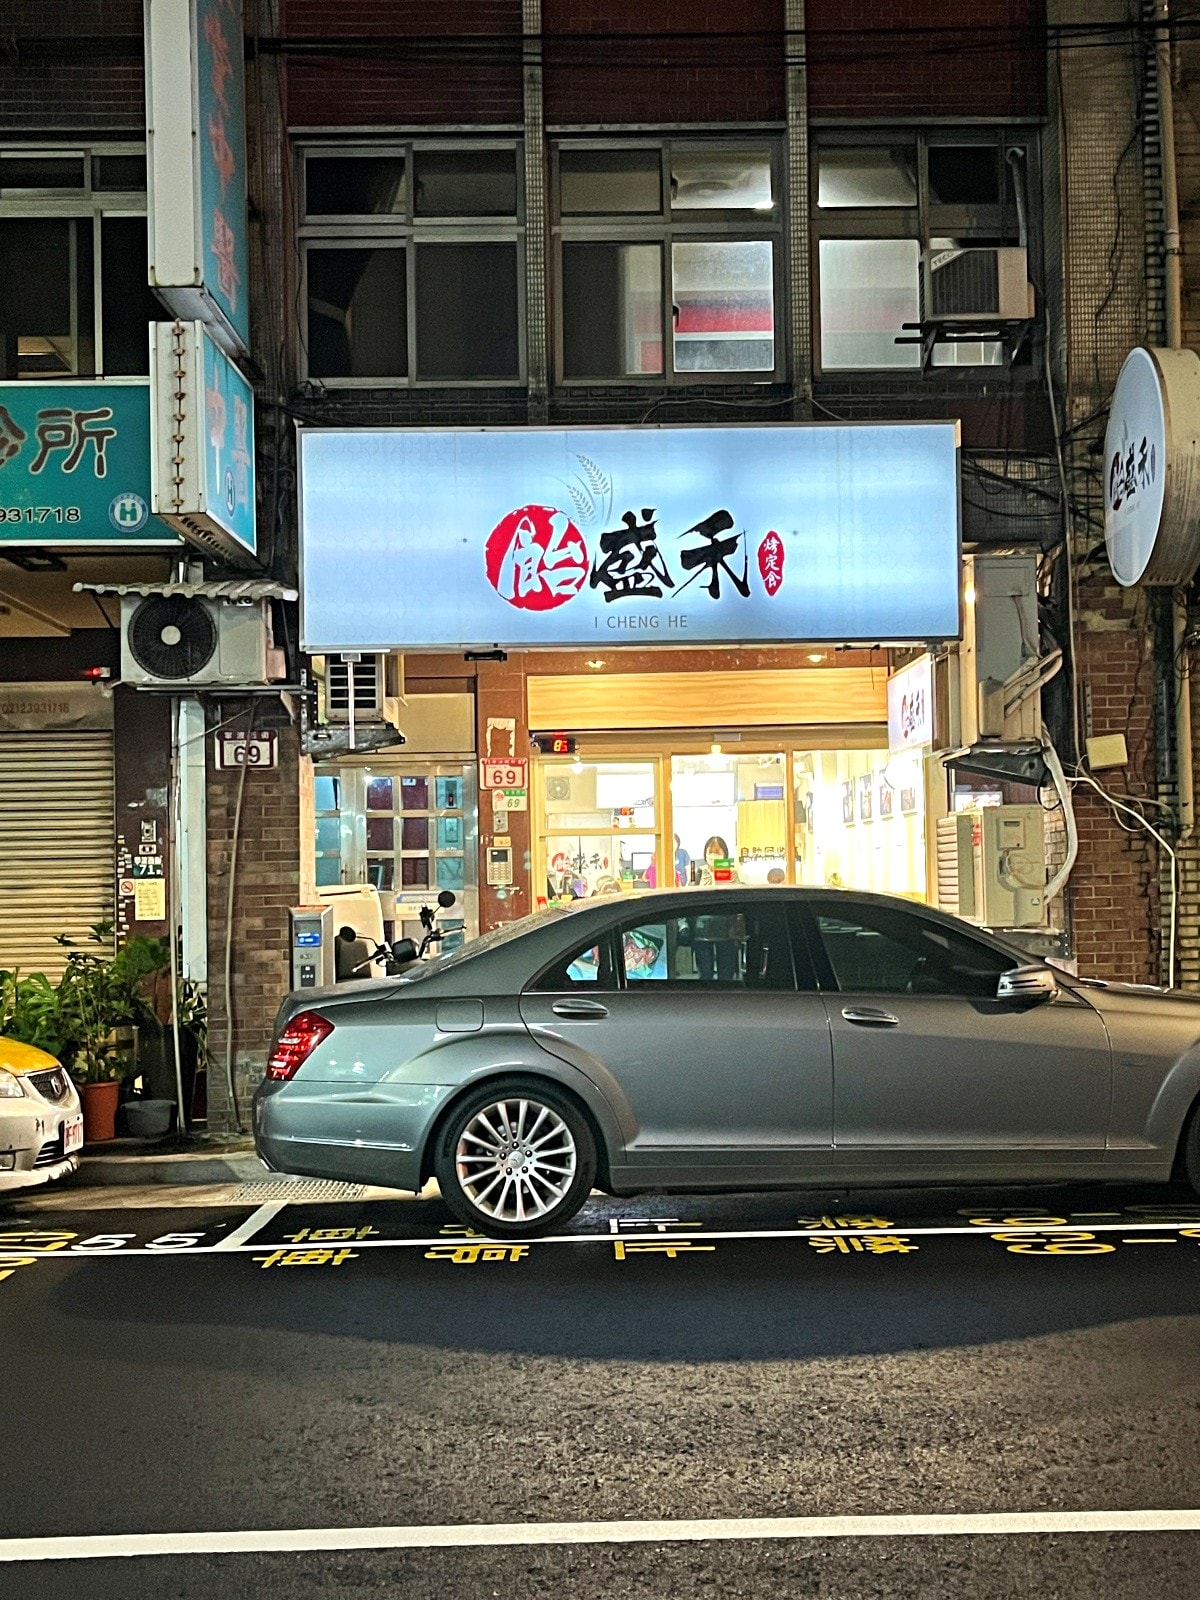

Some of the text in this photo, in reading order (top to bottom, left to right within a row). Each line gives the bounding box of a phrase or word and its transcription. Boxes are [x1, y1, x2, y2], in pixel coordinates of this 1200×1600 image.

[0, 404, 117, 478] 所
[763, 536, 781, 588] 烤定食
[607, 615, 660, 629] CHENG
[668, 615, 688, 628] HE
[234, 745, 261, 764] 69
[493, 770, 516, 785] 69
[507, 798, 520, 808] 69
[71, 1233, 207, 1251] 55
